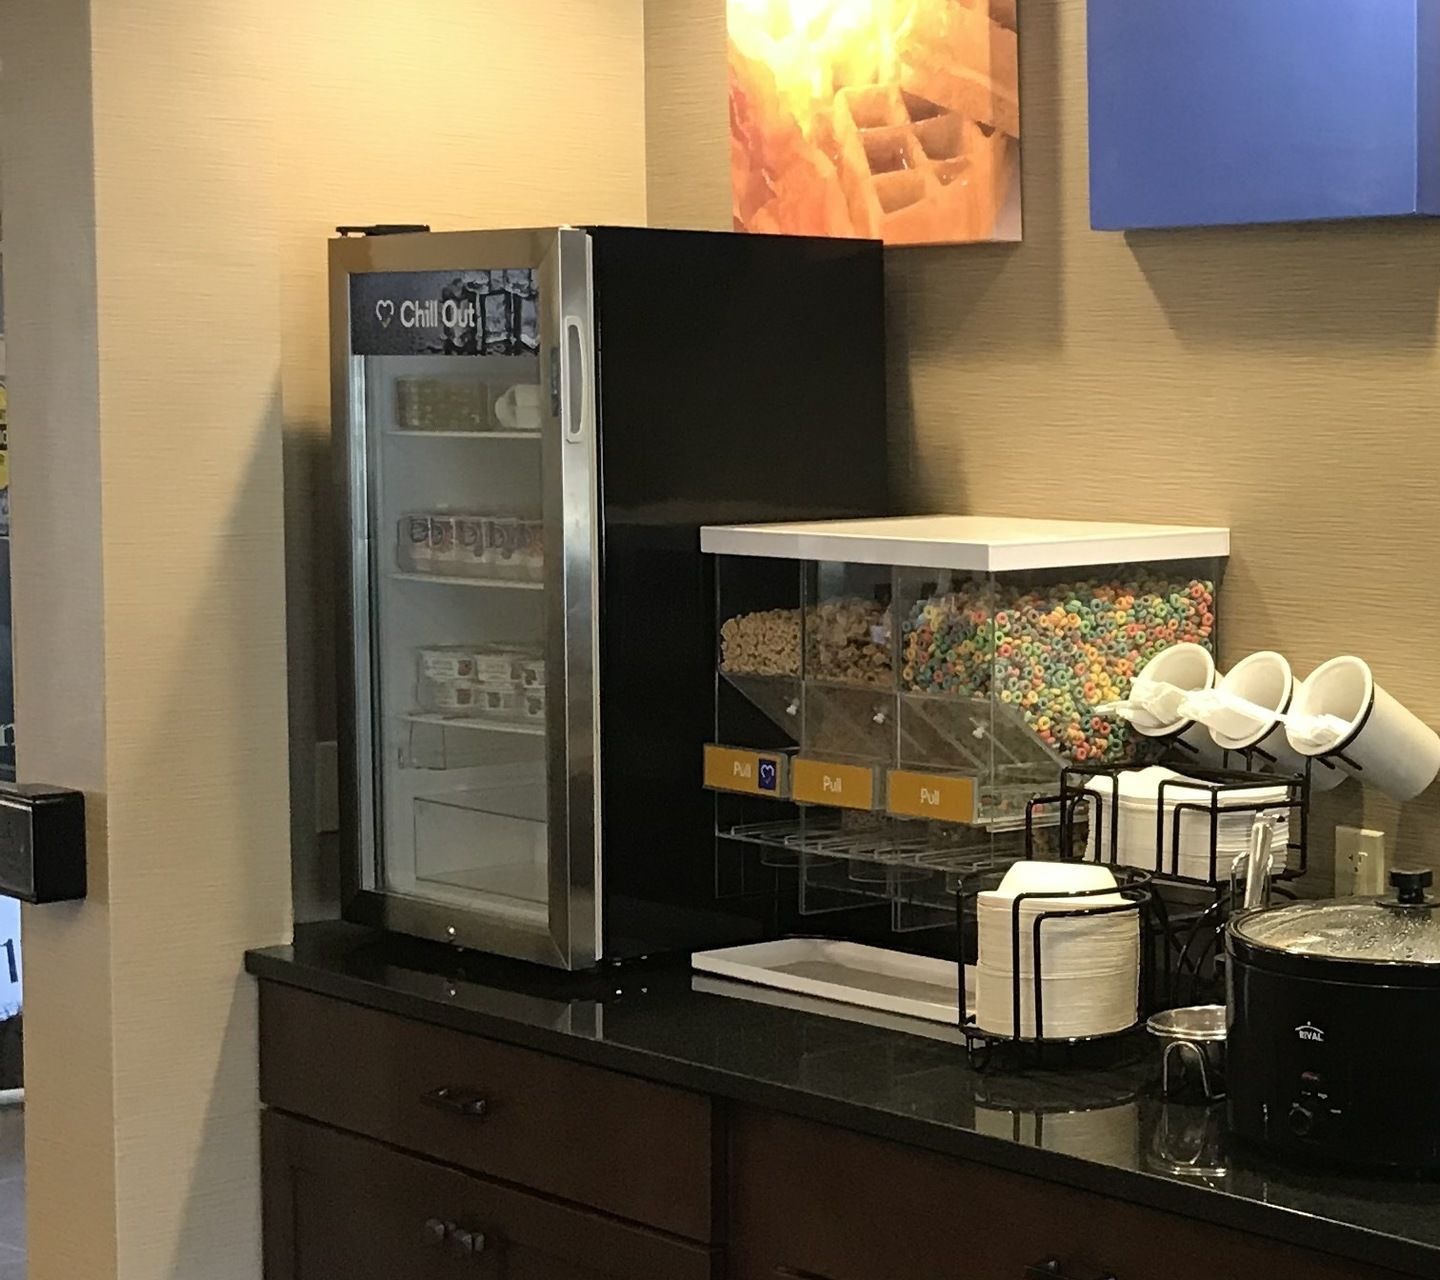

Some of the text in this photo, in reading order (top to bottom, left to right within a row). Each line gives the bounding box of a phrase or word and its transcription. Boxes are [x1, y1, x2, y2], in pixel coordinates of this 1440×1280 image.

[400, 300, 476, 328] Chill Out
[733, 761, 752, 778] Pull
[822, 775, 843, 794] Pull
[919, 787, 941, 807] Pull
[1299, 1030, 1325, 1042] RIVAL
